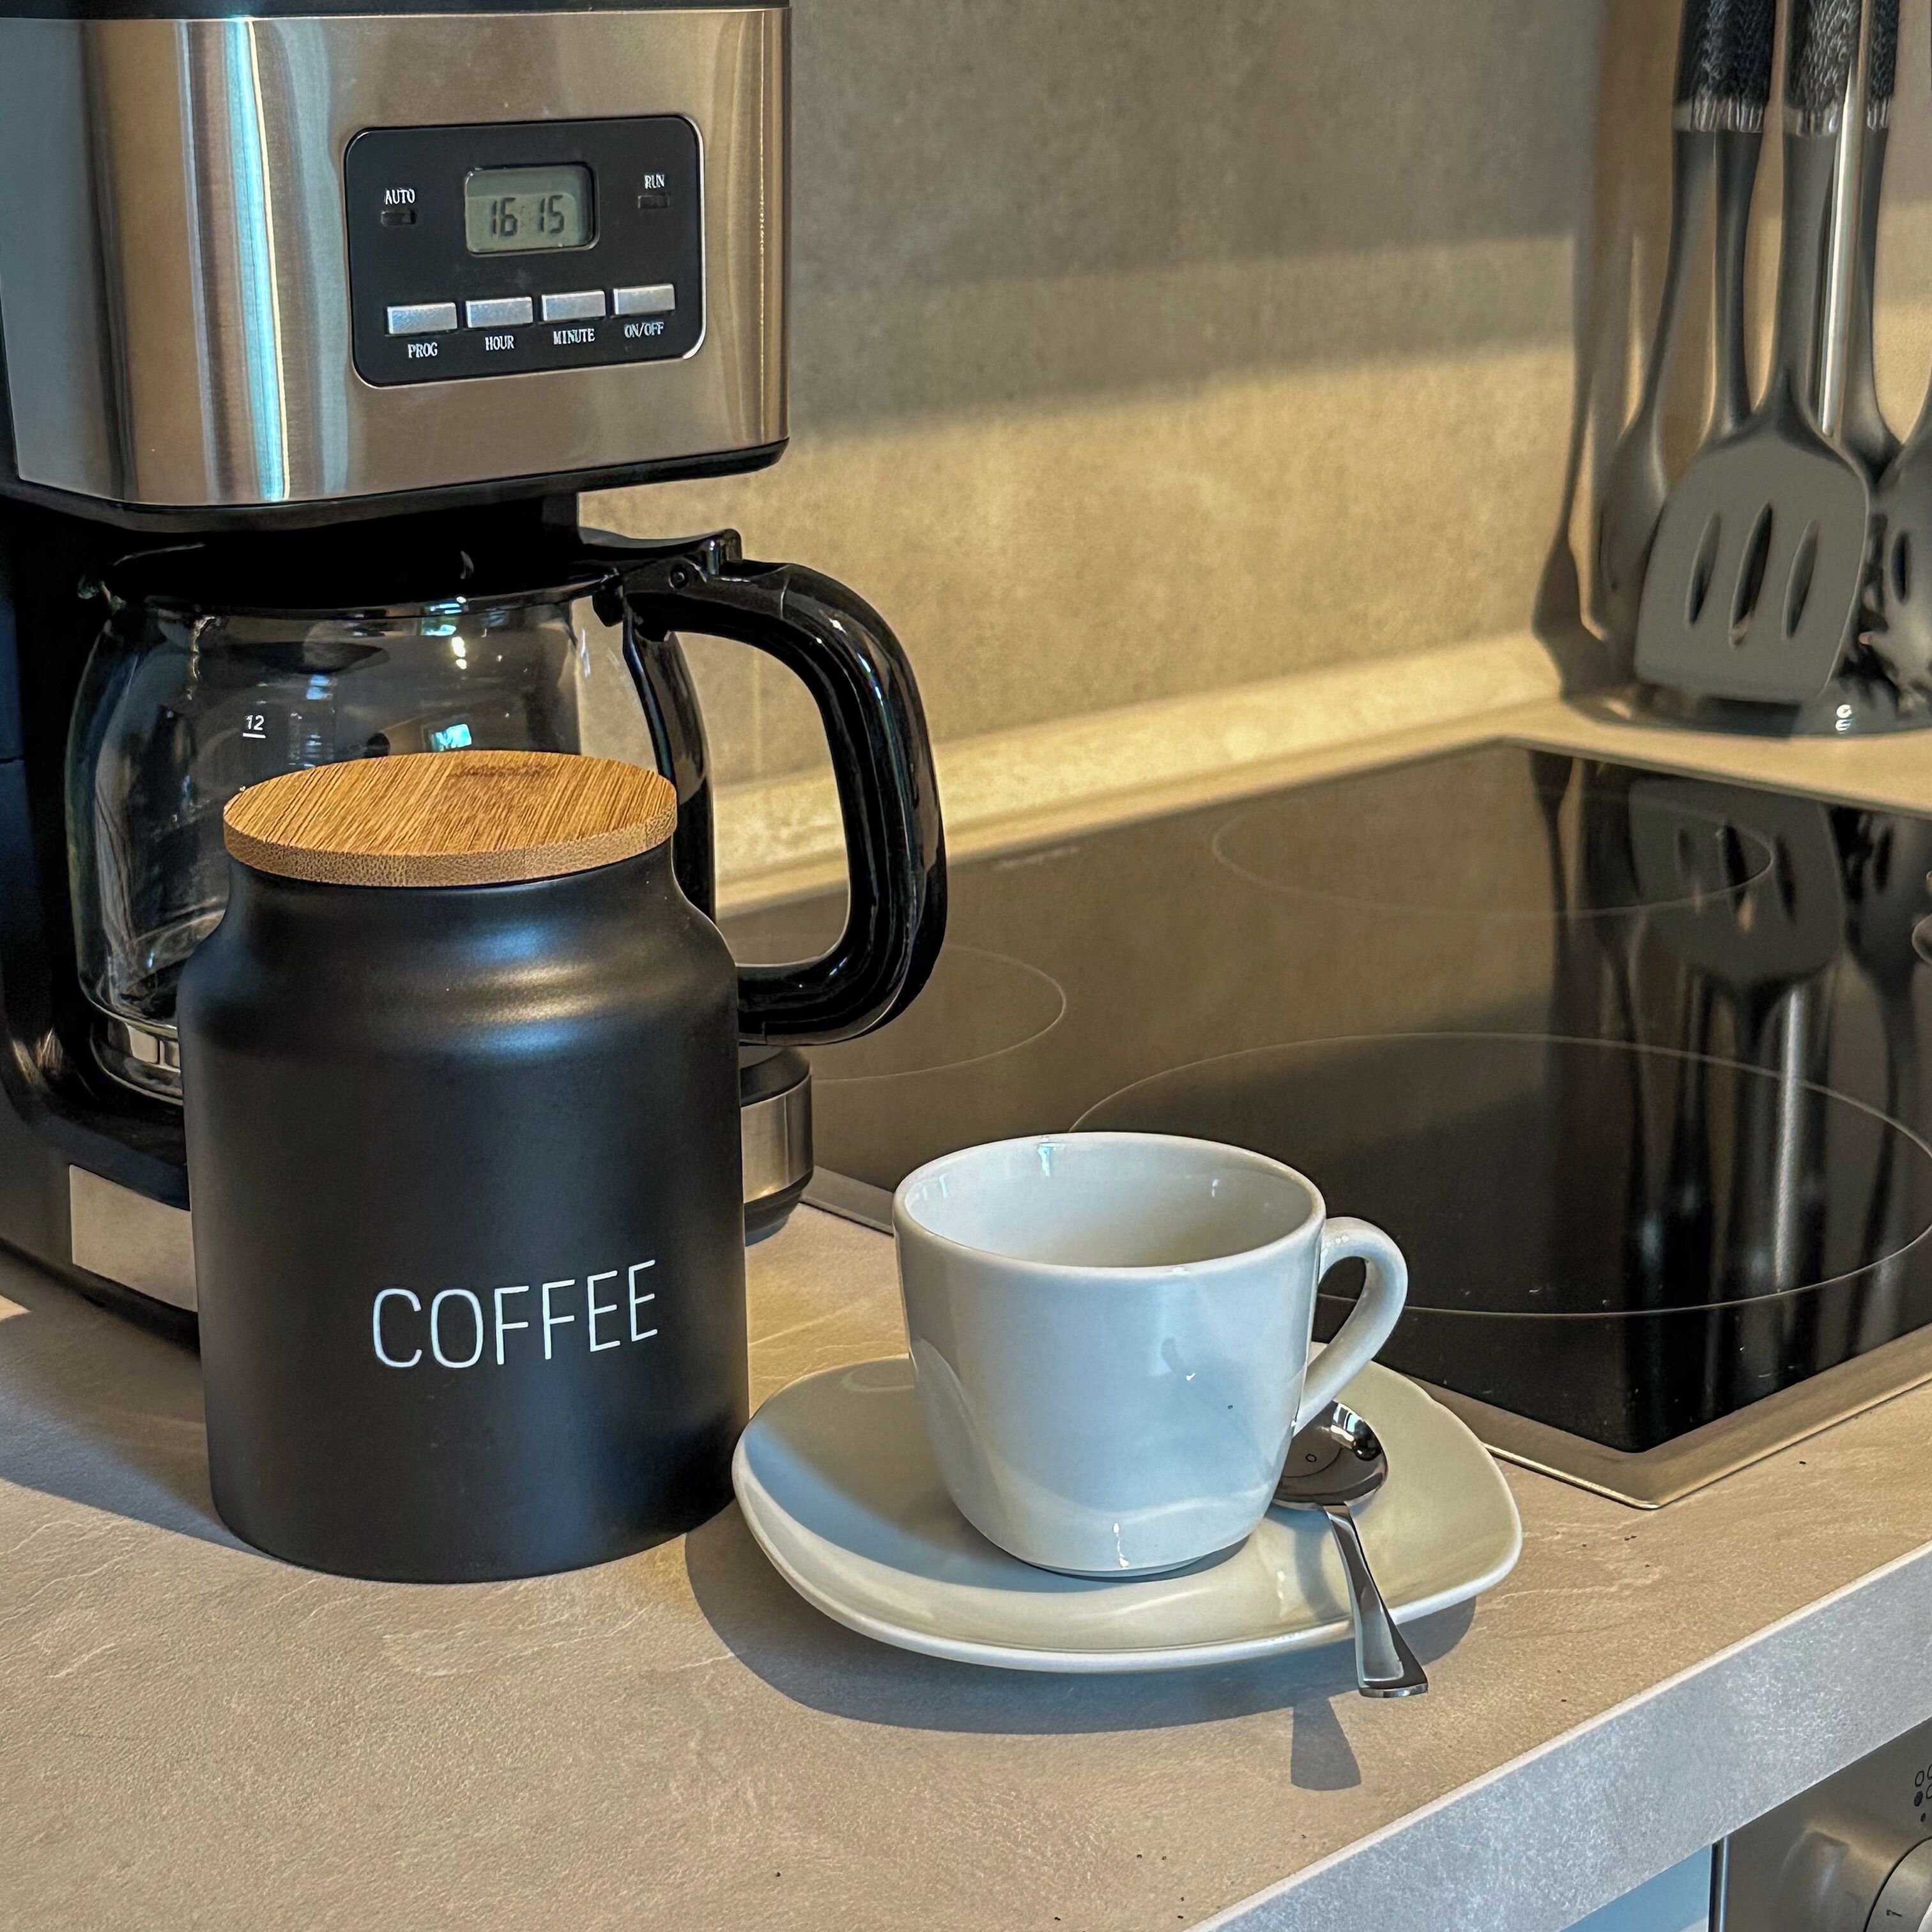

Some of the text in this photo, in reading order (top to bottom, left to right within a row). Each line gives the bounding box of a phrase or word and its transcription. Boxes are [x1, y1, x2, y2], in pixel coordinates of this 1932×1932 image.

[644, 173, 665, 190] RUN
[384, 188, 415, 205] AUTO
[553, 328, 595, 345] MINUTE
[624, 321, 664, 338] ON/OFF
[408, 341, 438, 358] PROG
[485, 335, 515, 351] HOUR
[245, 714, 264, 731] 12
[372, 1259, 658, 1368] COFFEE
